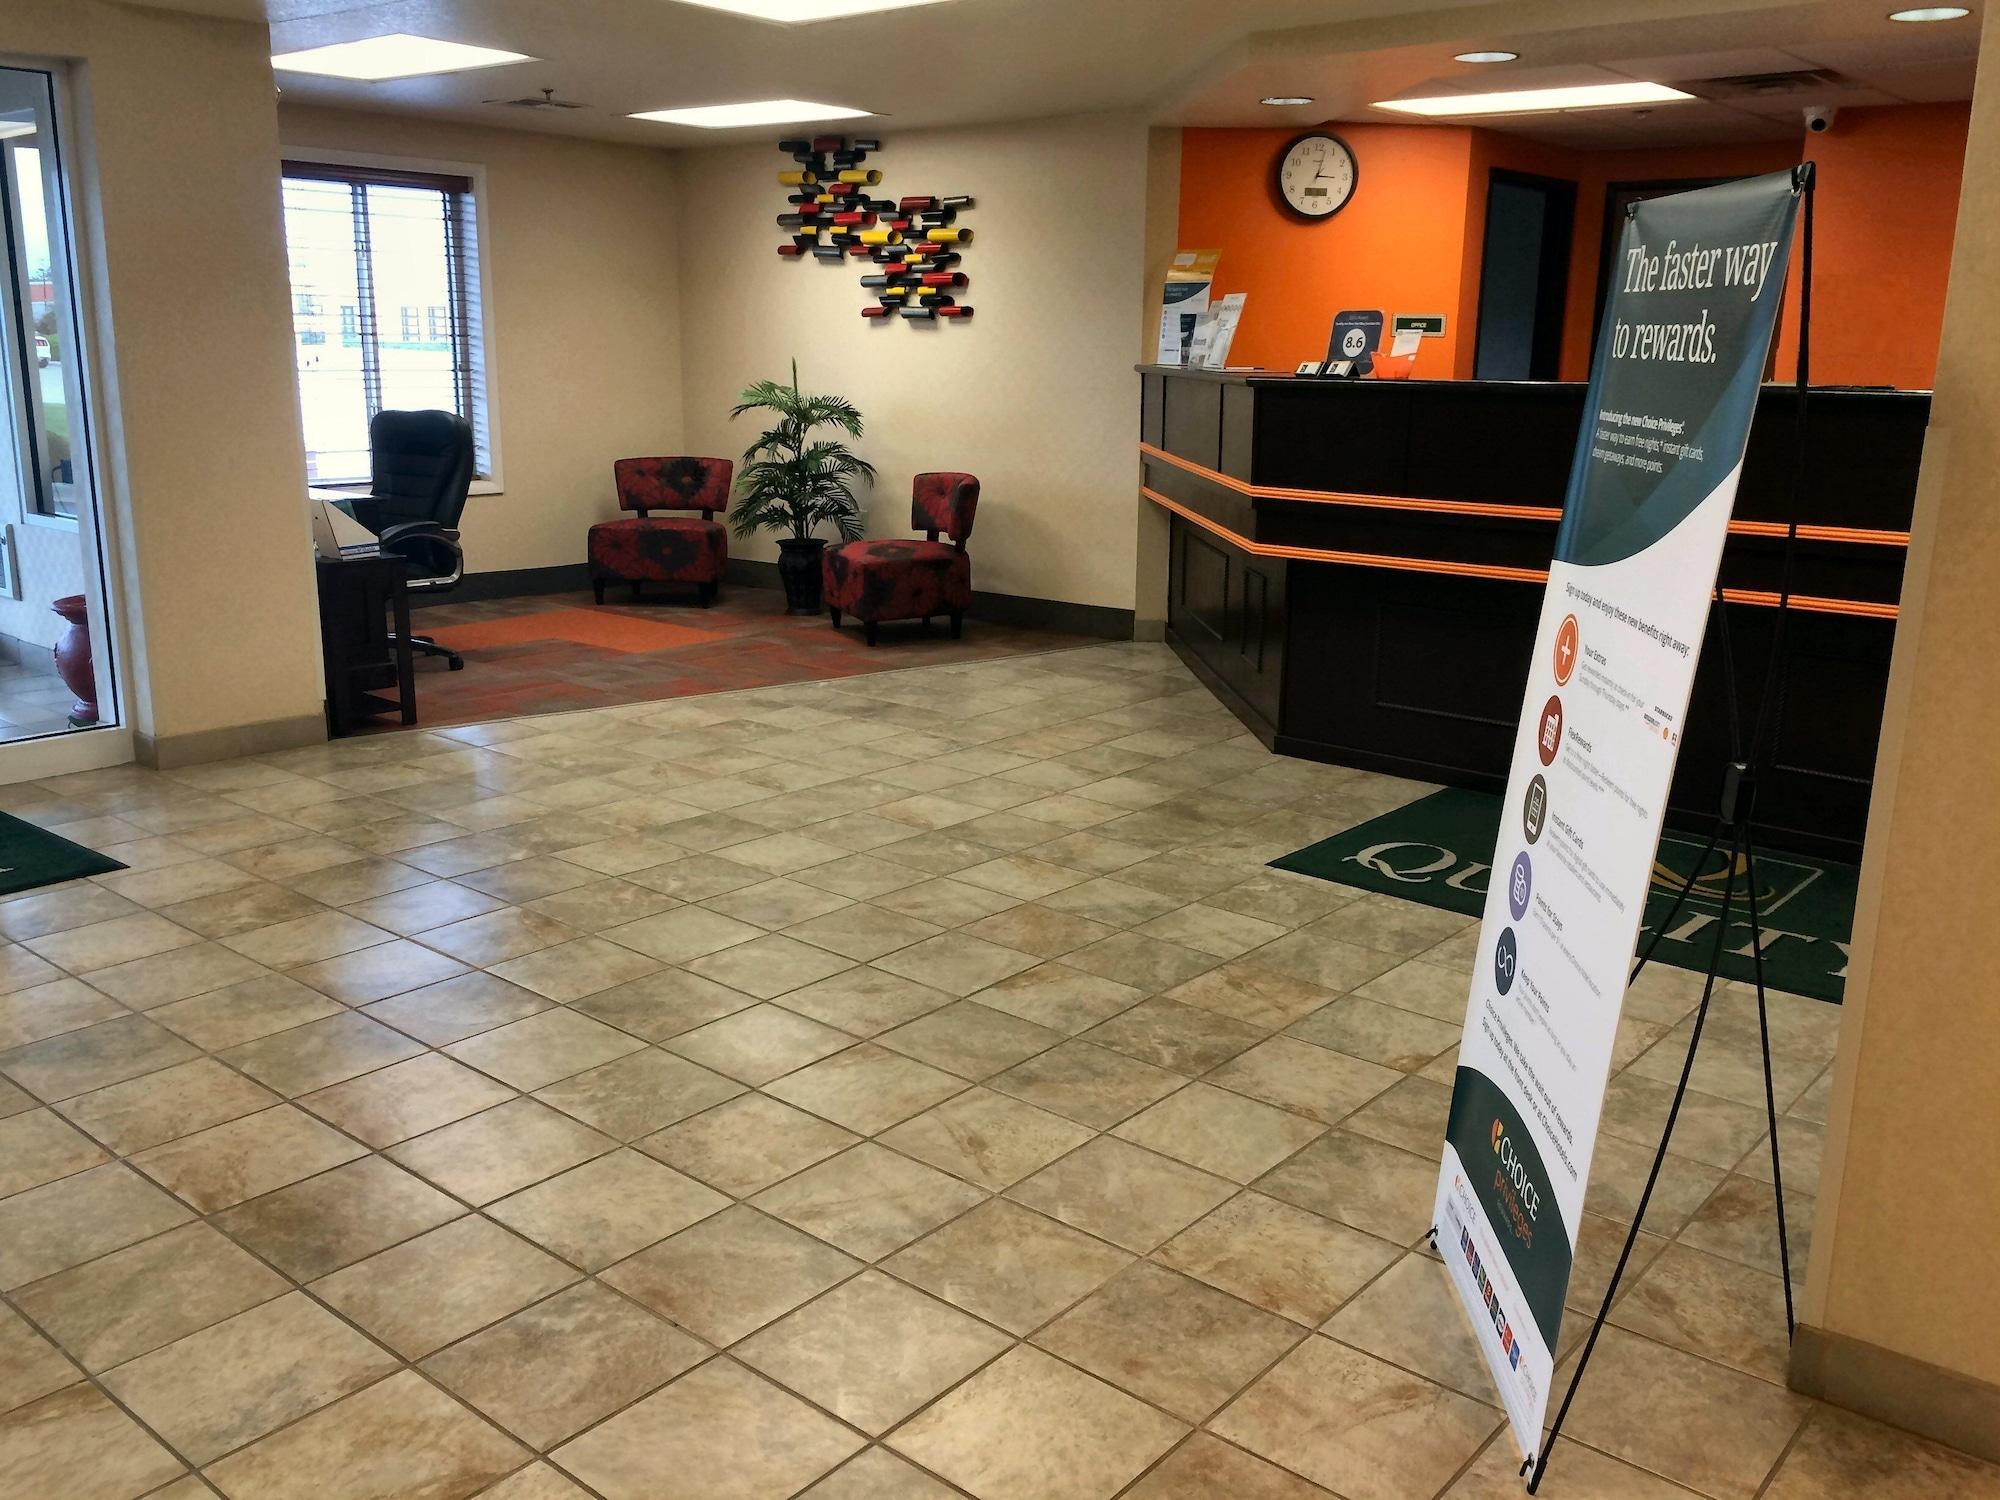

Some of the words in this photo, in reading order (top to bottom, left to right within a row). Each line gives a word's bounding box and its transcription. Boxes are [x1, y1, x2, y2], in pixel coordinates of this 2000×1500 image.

[1302, 147, 1310, 156] 11
[1314, 143, 1325, 152] 12
[1291, 158, 1302, 166] 10
[1339, 159, 1345, 168] 2
[1286, 171, 1292, 179] 9
[1342, 172, 1348, 181] 3
[1289, 185, 1296, 193] 8
[1336, 187, 1342, 195] 4
[1298, 196, 1305, 205] 7
[1311, 200, 1318, 209] 6
[1326, 197, 1332, 205] 5
[1624, 244, 1659, 293] The
[1659, 240, 1721, 291] faster
[1725, 241, 1778, 302] way
[1345, 336, 1363, 348] 8.6
[1612, 318, 1628, 359] to
[1630, 309, 1717, 363] rewards.
[1600, 409, 1623, 428] Introducing
[1621, 413, 1631, 425] the
[1630, 416, 1642, 426] new
[1640, 415, 1658, 429] Choice
[1596, 428, 1599, 437] A
[1609, 432, 1619, 446] way
[1618, 434, 1624, 443] to
[1663, 440, 1680, 455] instant
[1678, 444, 1689, 460] gift
[1624, 454, 1635, 466] and
[1633, 455, 1647, 469] more
[1566, 582, 1574, 597] Sign
[1575, 590, 1580, 599] up
[1579, 591, 1592, 607] today
[1592, 597, 1601, 609] and
[1601, 602, 1614, 618] enjoy
[1614, 607, 1627, 623] these
[1627, 616, 1638, 628] new
[1638, 619, 1659, 639] benefits
[1658, 631, 1672, 647] right
[1585, 645, 1594, 657] Your
[1594, 650, 1606, 666] Extras
[1552, 812, 1565, 831] Instant
[1572, 832, 1583, 849] Cards
[1536, 893, 1547, 912] Points
[1552, 913, 1562, 931] Stays
[1537, 991, 1549, 1013] Points
[1486, 999, 1496, 1021] Choice
[1512, 1042, 1519, 1057] We
[1520, 1053, 1528, 1071] take
[1534, 1078, 1544, 1096] wait
[1550, 1102, 1557, 1115] of
[1489, 1030, 1494, 1041] up
[1493, 1036, 1504, 1058] today
[1503, 1052, 1508, 1064] at
[1514, 1068, 1523, 1090] front
[1524, 1086, 1532, 1104] desk
[1533, 1101, 1537, 1112] or
[1537, 1109, 1542, 1120] at
[1500, 1136, 1540, 1221] CHOICE
[1494, 1170, 1532, 1249] privileges
